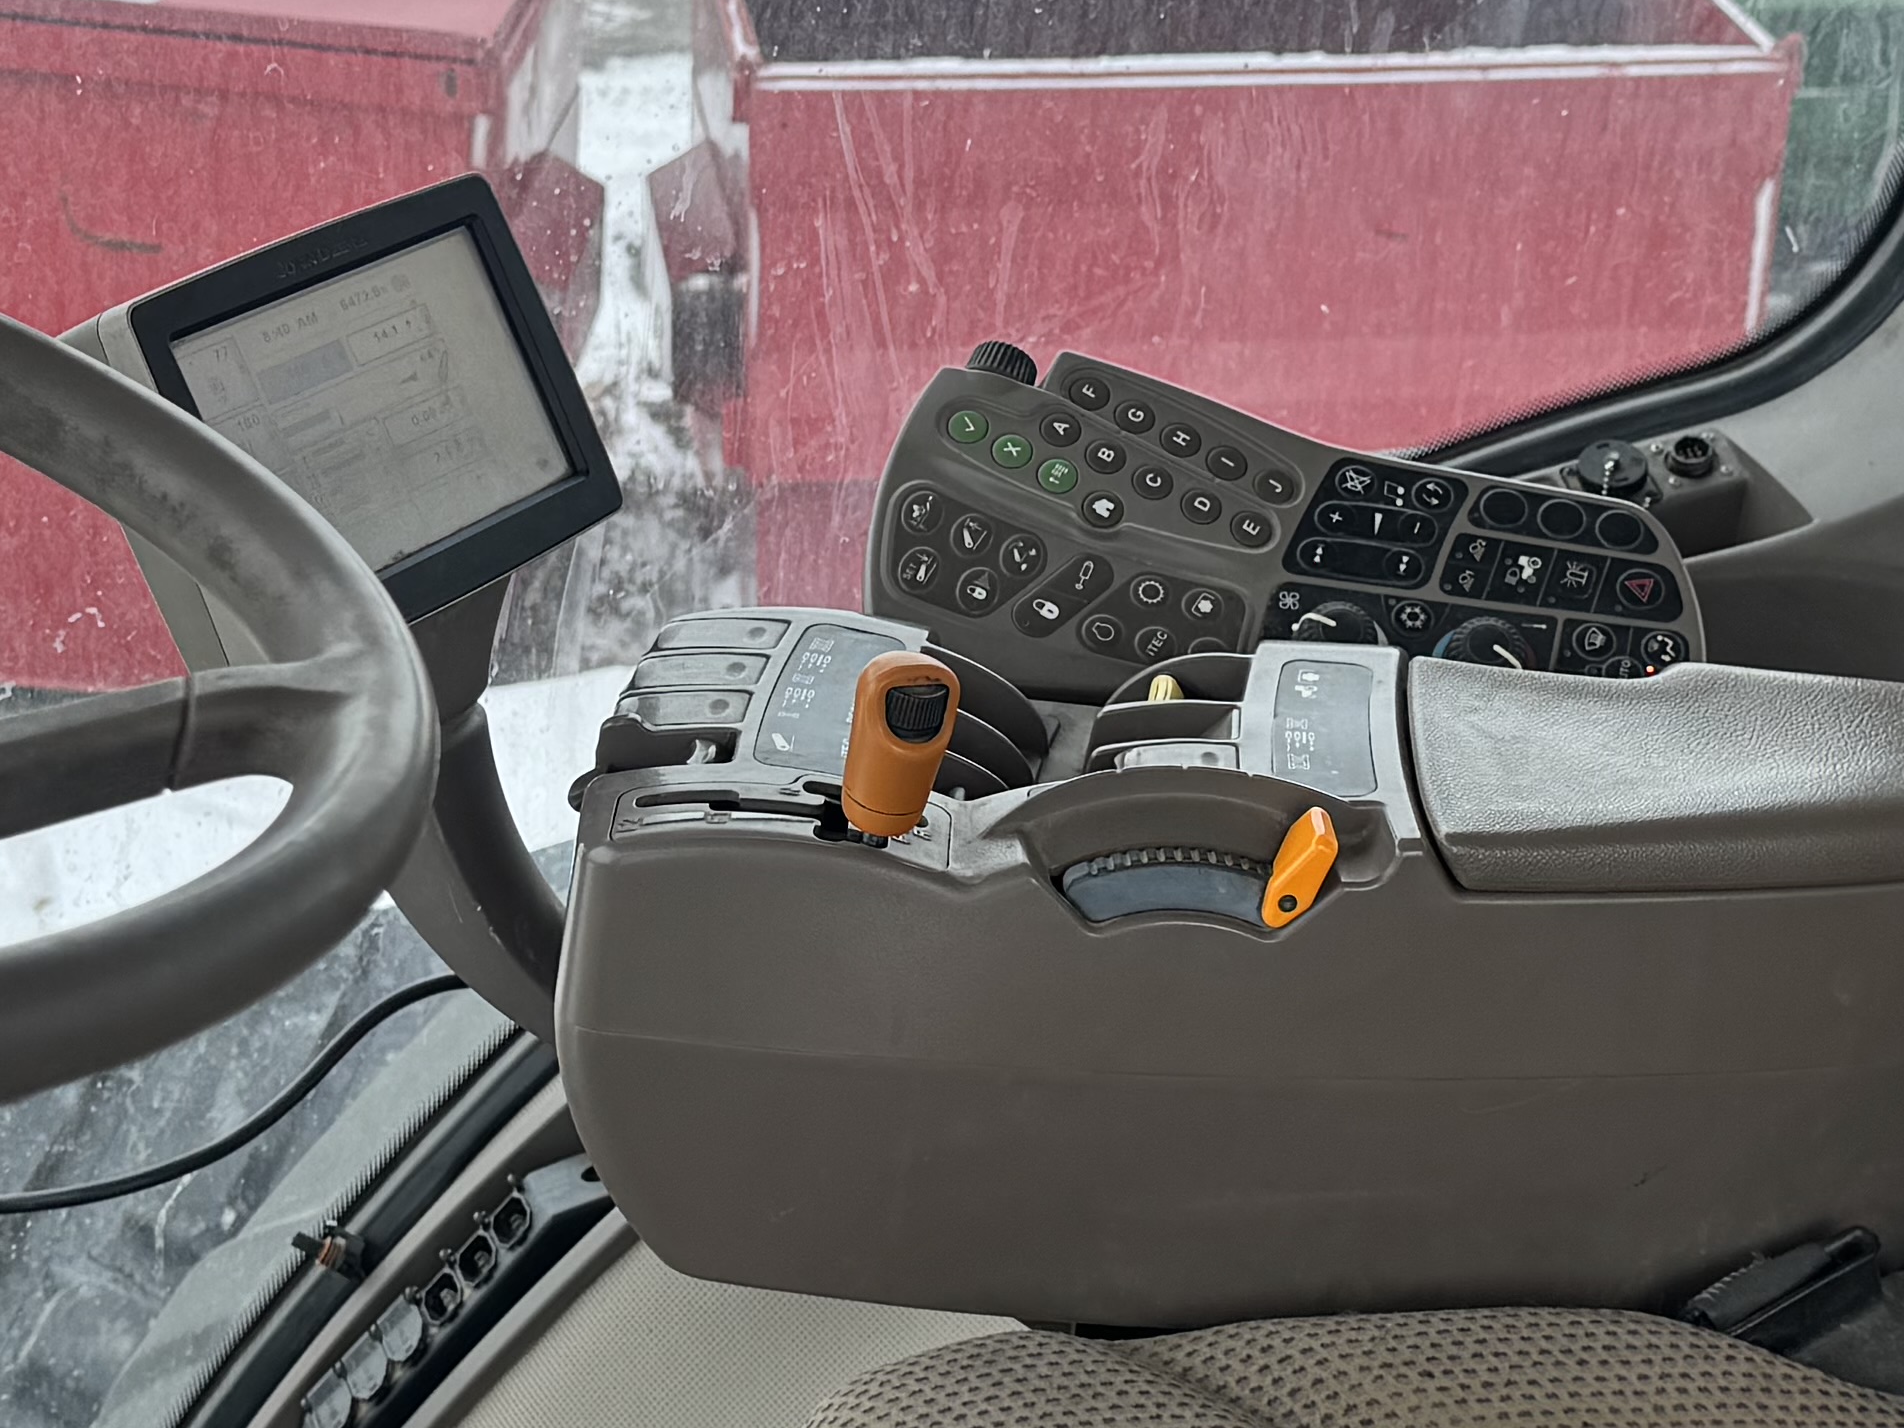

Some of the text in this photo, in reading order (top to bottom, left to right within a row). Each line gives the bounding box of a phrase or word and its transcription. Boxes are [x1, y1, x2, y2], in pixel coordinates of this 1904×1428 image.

[1081, 383, 1096, 398] F
[1127, 408, 1145, 422] G
[1052, 422, 1070, 436] A
[1172, 430, 1191, 446] H
[1097, 447, 1115, 462] B
[1145, 473, 1162, 487] C
[1193, 496, 1211, 512] D
[1242, 519, 1261, 536] E
